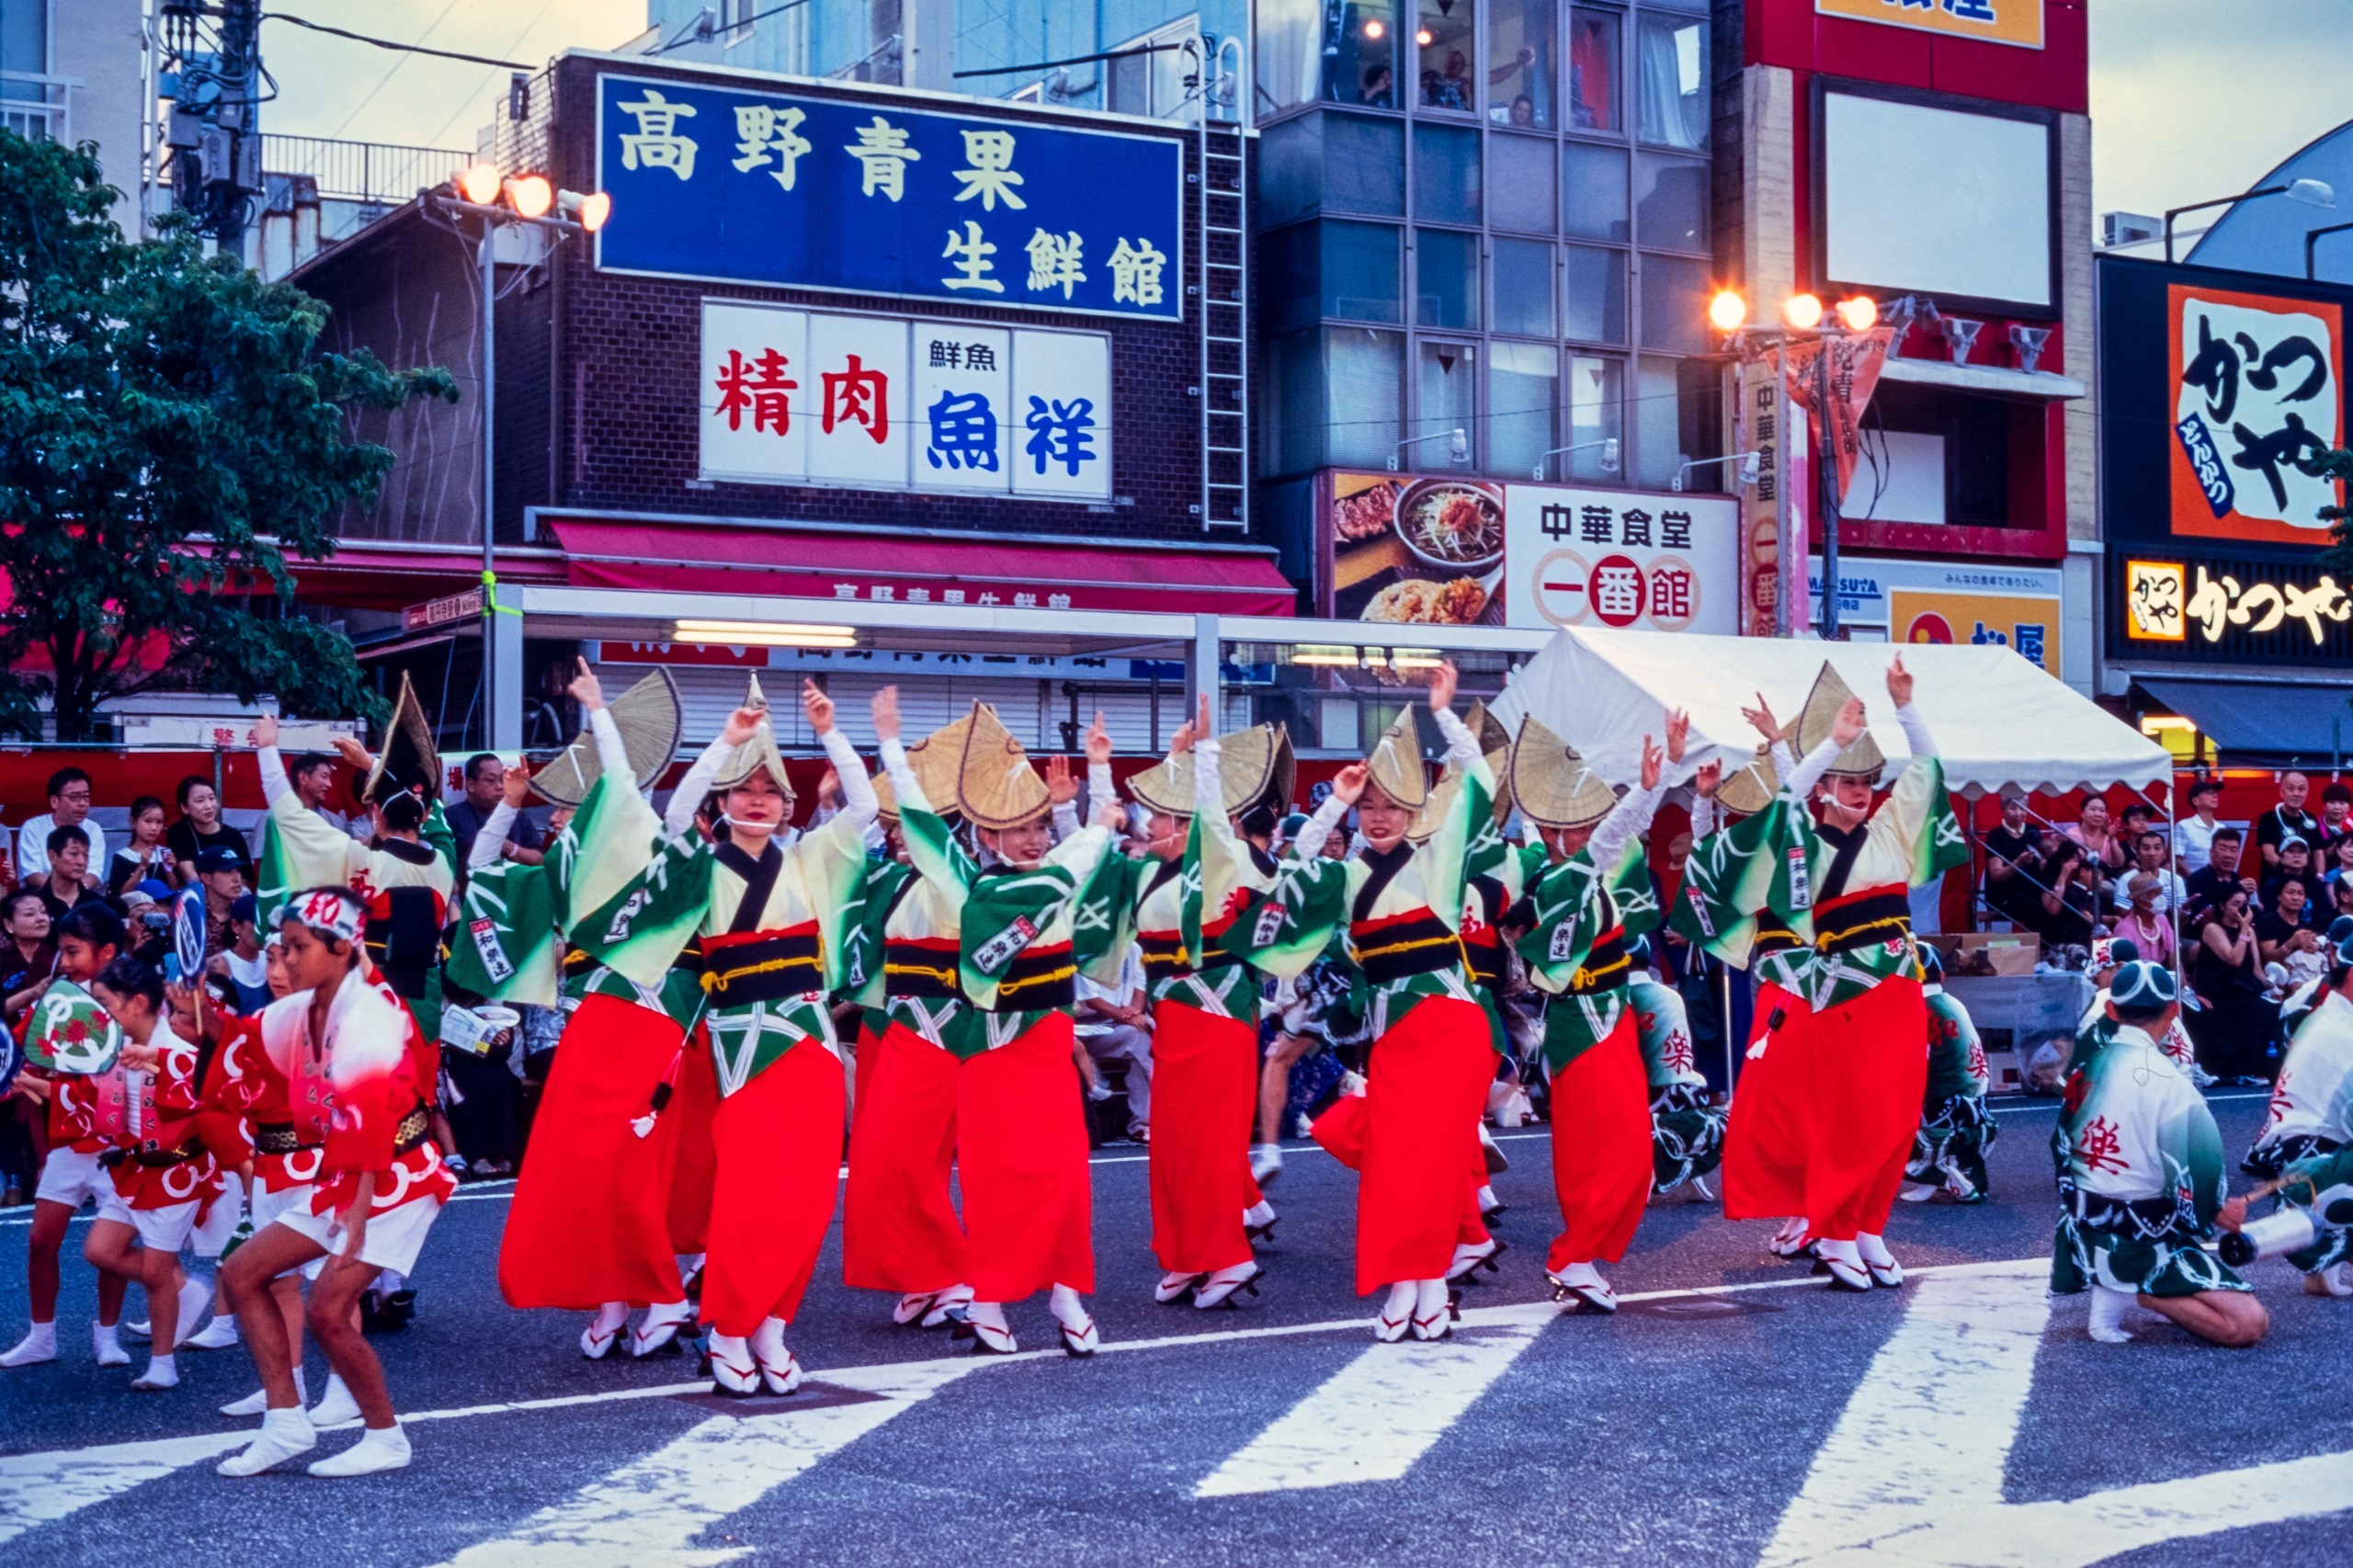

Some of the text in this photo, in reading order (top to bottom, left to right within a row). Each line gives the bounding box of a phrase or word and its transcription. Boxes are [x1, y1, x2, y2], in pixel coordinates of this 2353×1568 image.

[618, 91, 1027, 211] 高野青果
[941, 221, 1167, 307] 生鮮館
[713, 347, 889, 444] 精肉
[928, 339, 997, 372] 鮮魚
[926, 390, 1097, 476] 魚祥
[2179, 420, 2228, 505] とんかつ
[1541, 503, 1692, 550] 中華食堂
[1543, 566, 1690, 618] 一番館
[2185, 565, 2352, 645] かつや
